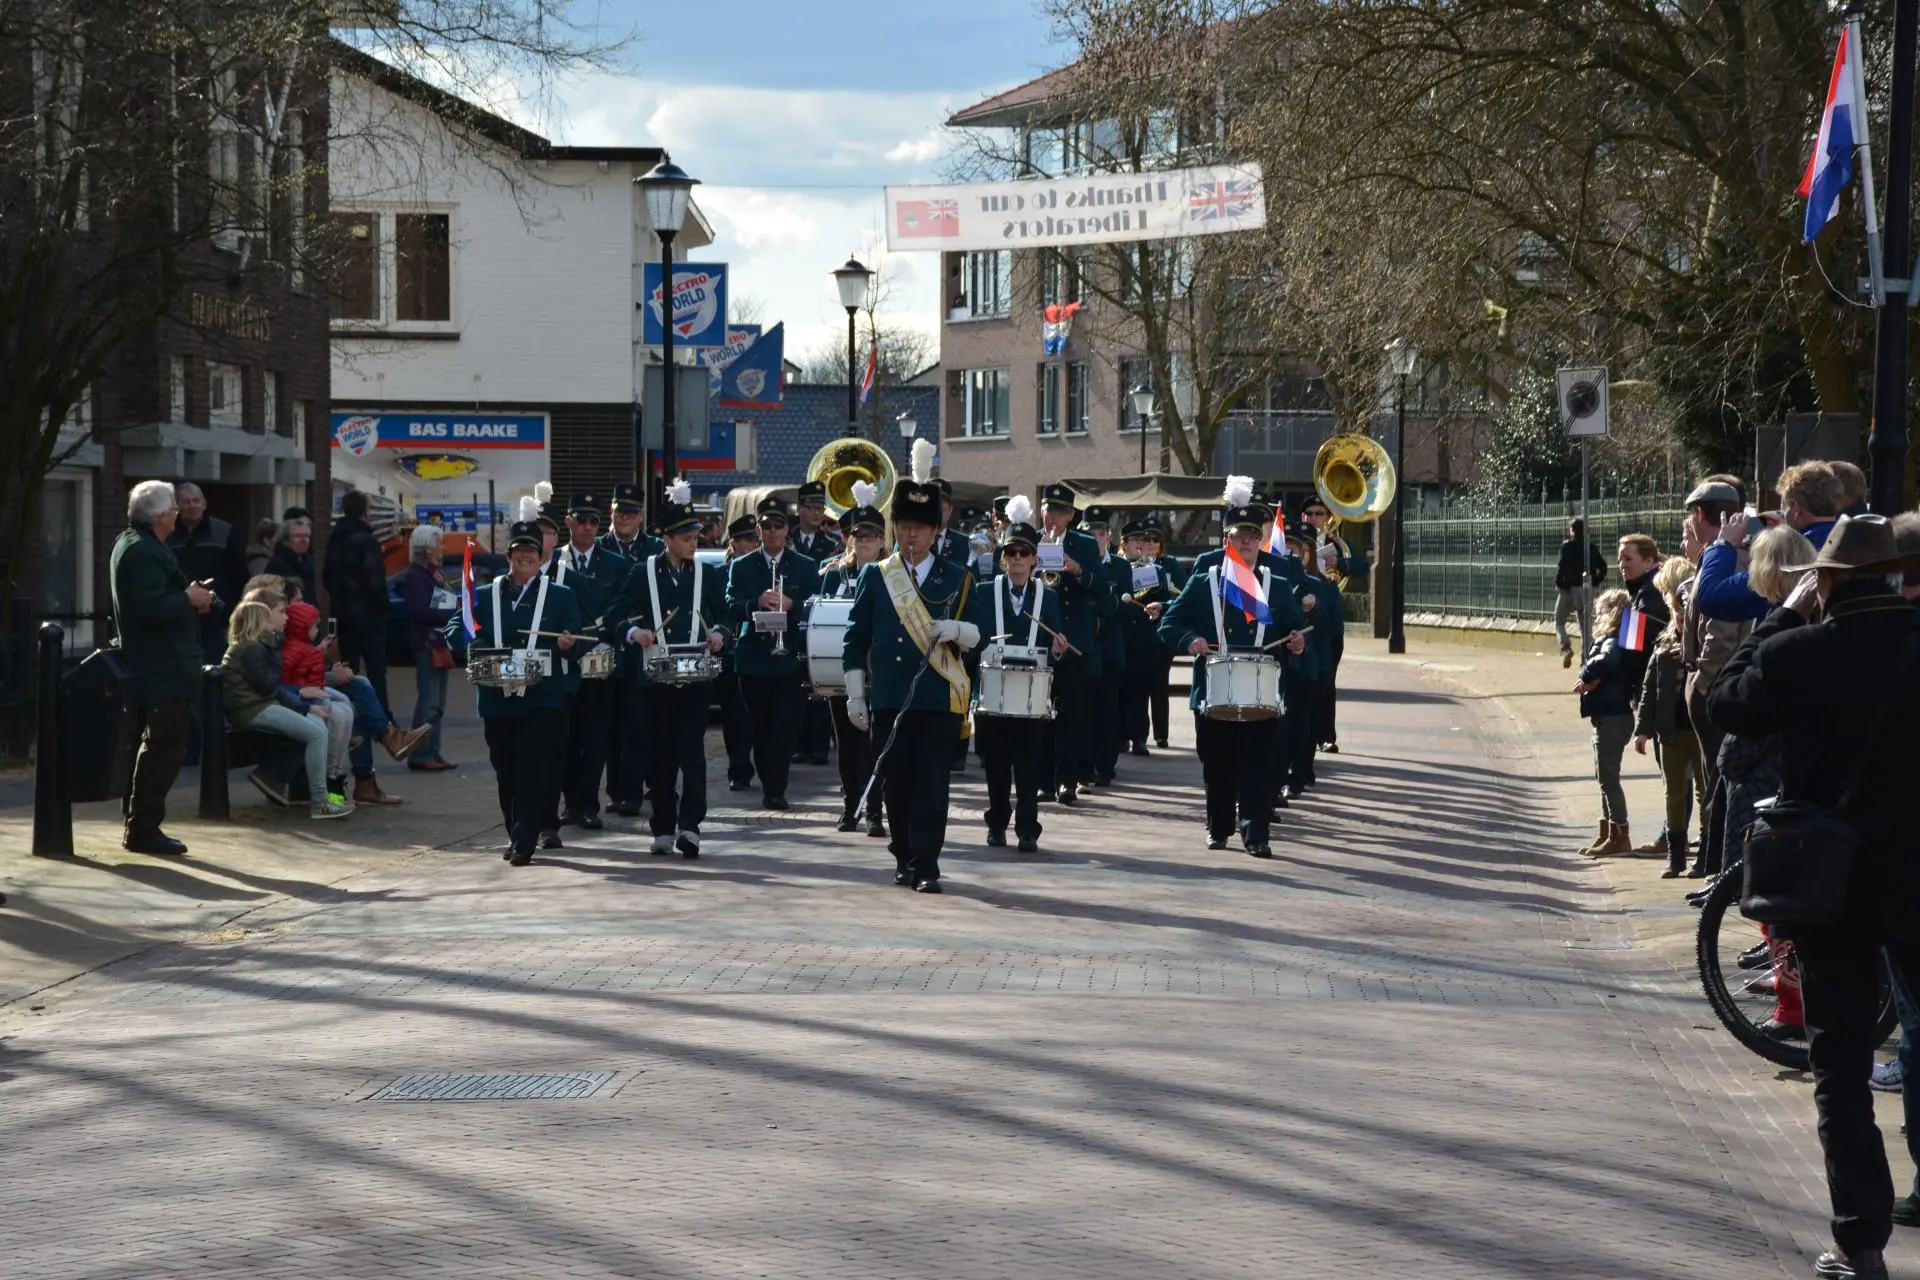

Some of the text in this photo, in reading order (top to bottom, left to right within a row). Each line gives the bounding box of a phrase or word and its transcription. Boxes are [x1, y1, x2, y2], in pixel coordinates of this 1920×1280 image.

[656, 275, 707, 299] EECTRO
[660, 287, 706, 310] ORLD
[344, 426, 370, 442] WORLD
[409, 423, 518, 437] BAS BAAKE
